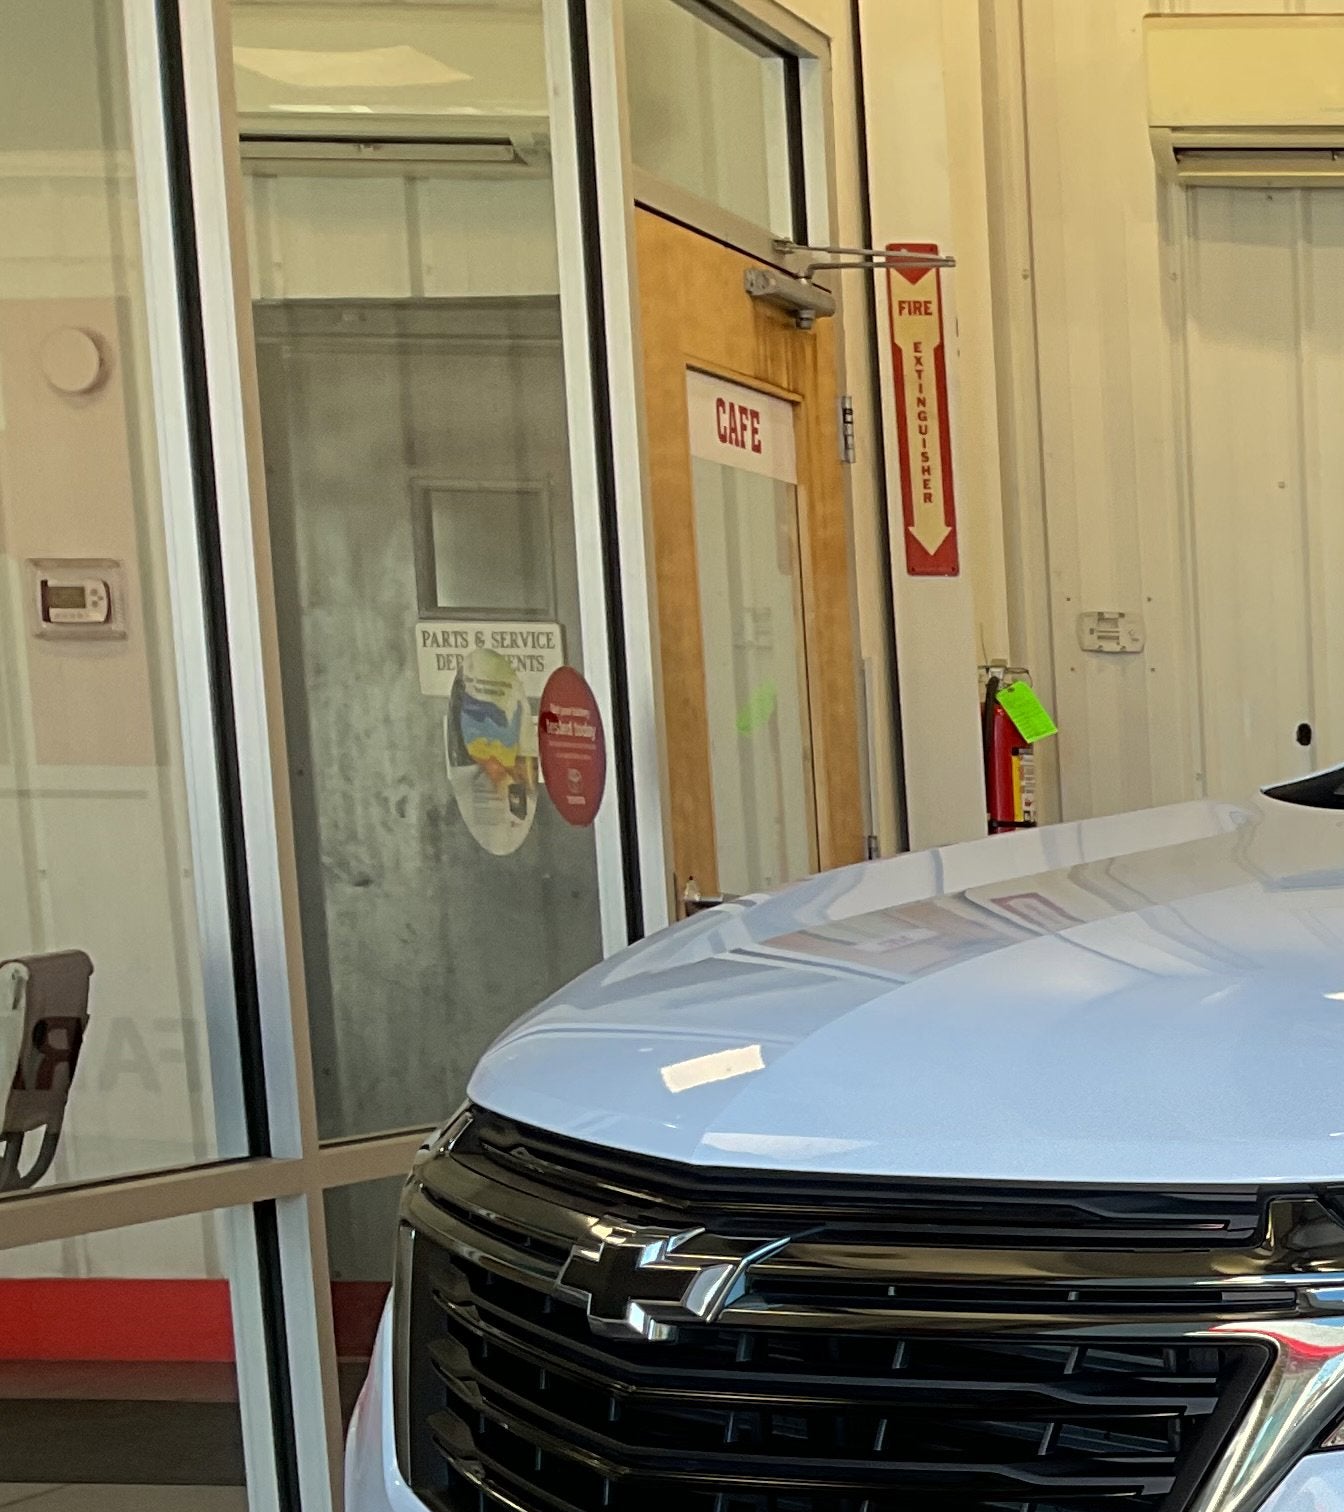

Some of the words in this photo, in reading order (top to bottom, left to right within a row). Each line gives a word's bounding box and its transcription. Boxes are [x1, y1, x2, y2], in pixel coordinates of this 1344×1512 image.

[898, 300, 933, 317] FIRE
[716, 397, 762, 455] CAFE
[913, 342, 933, 503] EXTINGUISHER
[421, 630, 469, 648] PARTS
[474, 630, 486, 649] &
[491, 631, 556, 649] SERVICE
[435, 653, 545, 672] DEPENTS
